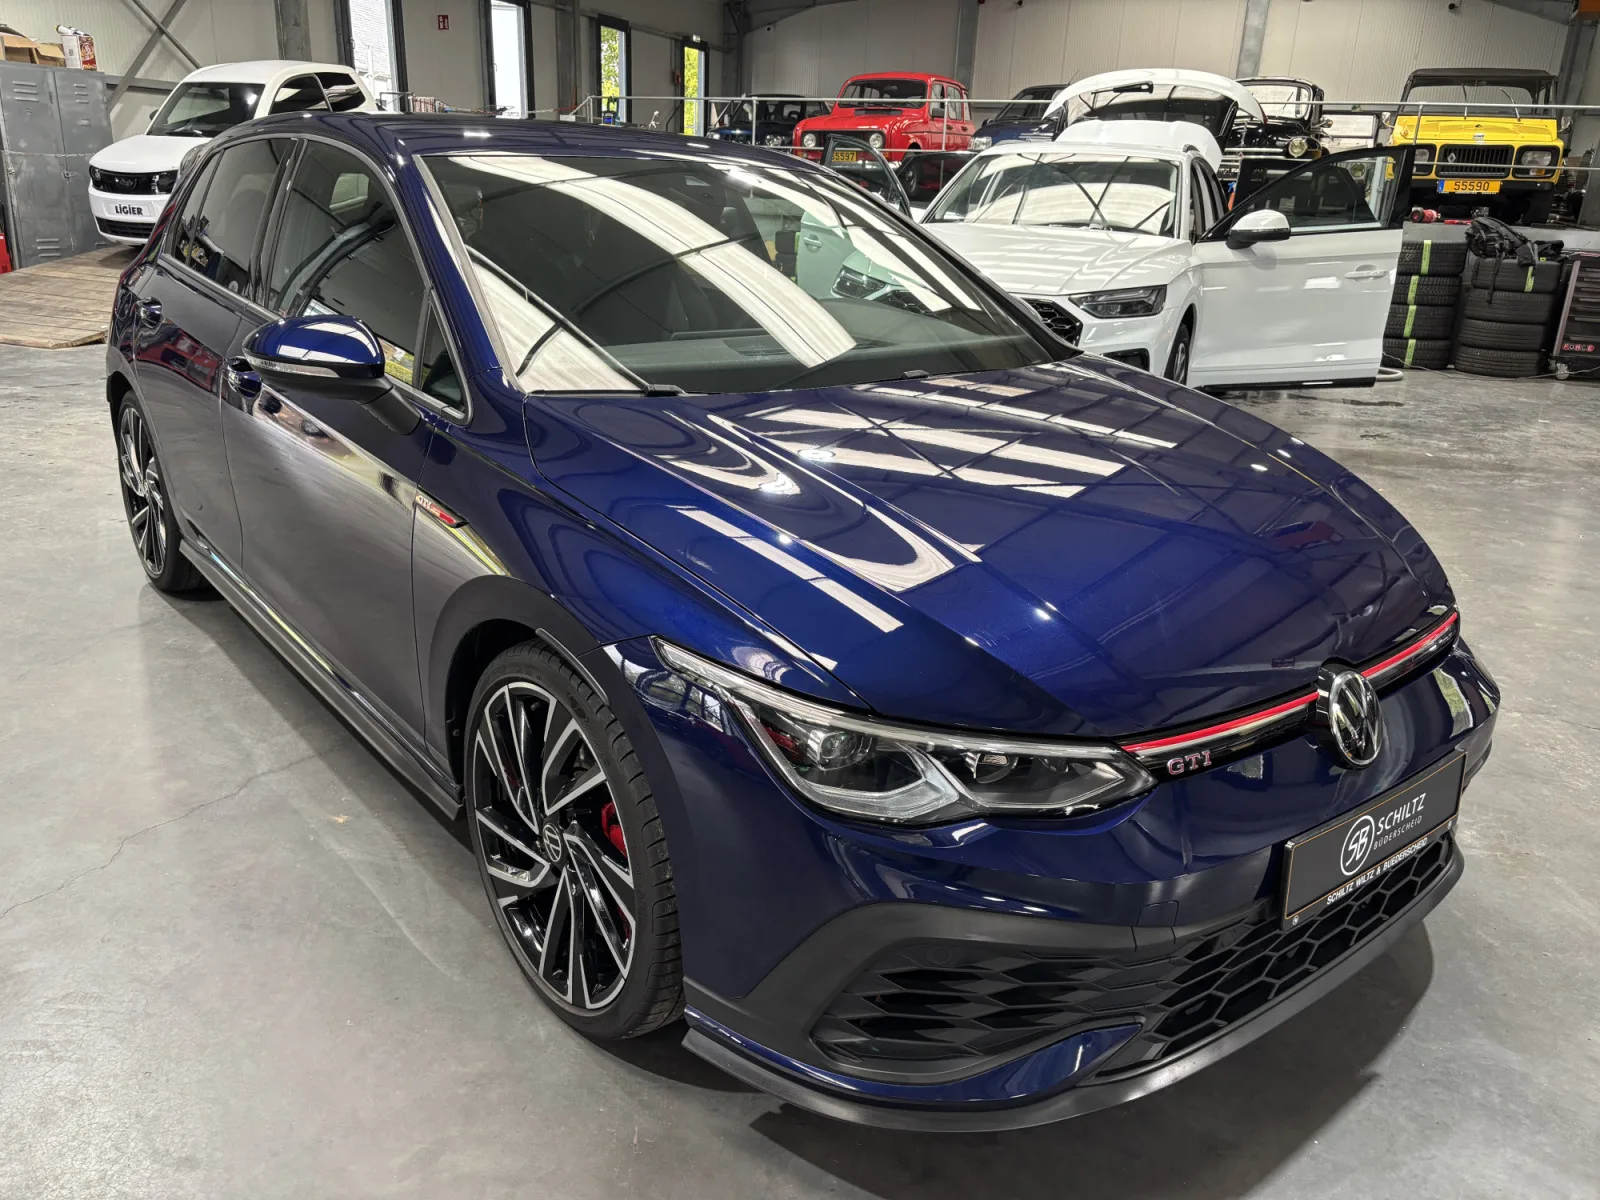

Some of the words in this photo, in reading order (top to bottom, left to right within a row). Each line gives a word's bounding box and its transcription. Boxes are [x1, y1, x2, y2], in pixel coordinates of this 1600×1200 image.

[1453, 181, 1490, 191] 55590
[1167, 750, 1212, 775] GTI
[1376, 793, 1427, 835] SCHILTZ
[1373, 815, 1423, 850] BÜDERSCHEID
[1326, 881, 1354, 905] SCHILTZ
[1355, 869, 1375, 888] WILTZ
[1375, 866, 1381, 876] &
[1382, 837, 1428, 871] BUEDERSCHEID
